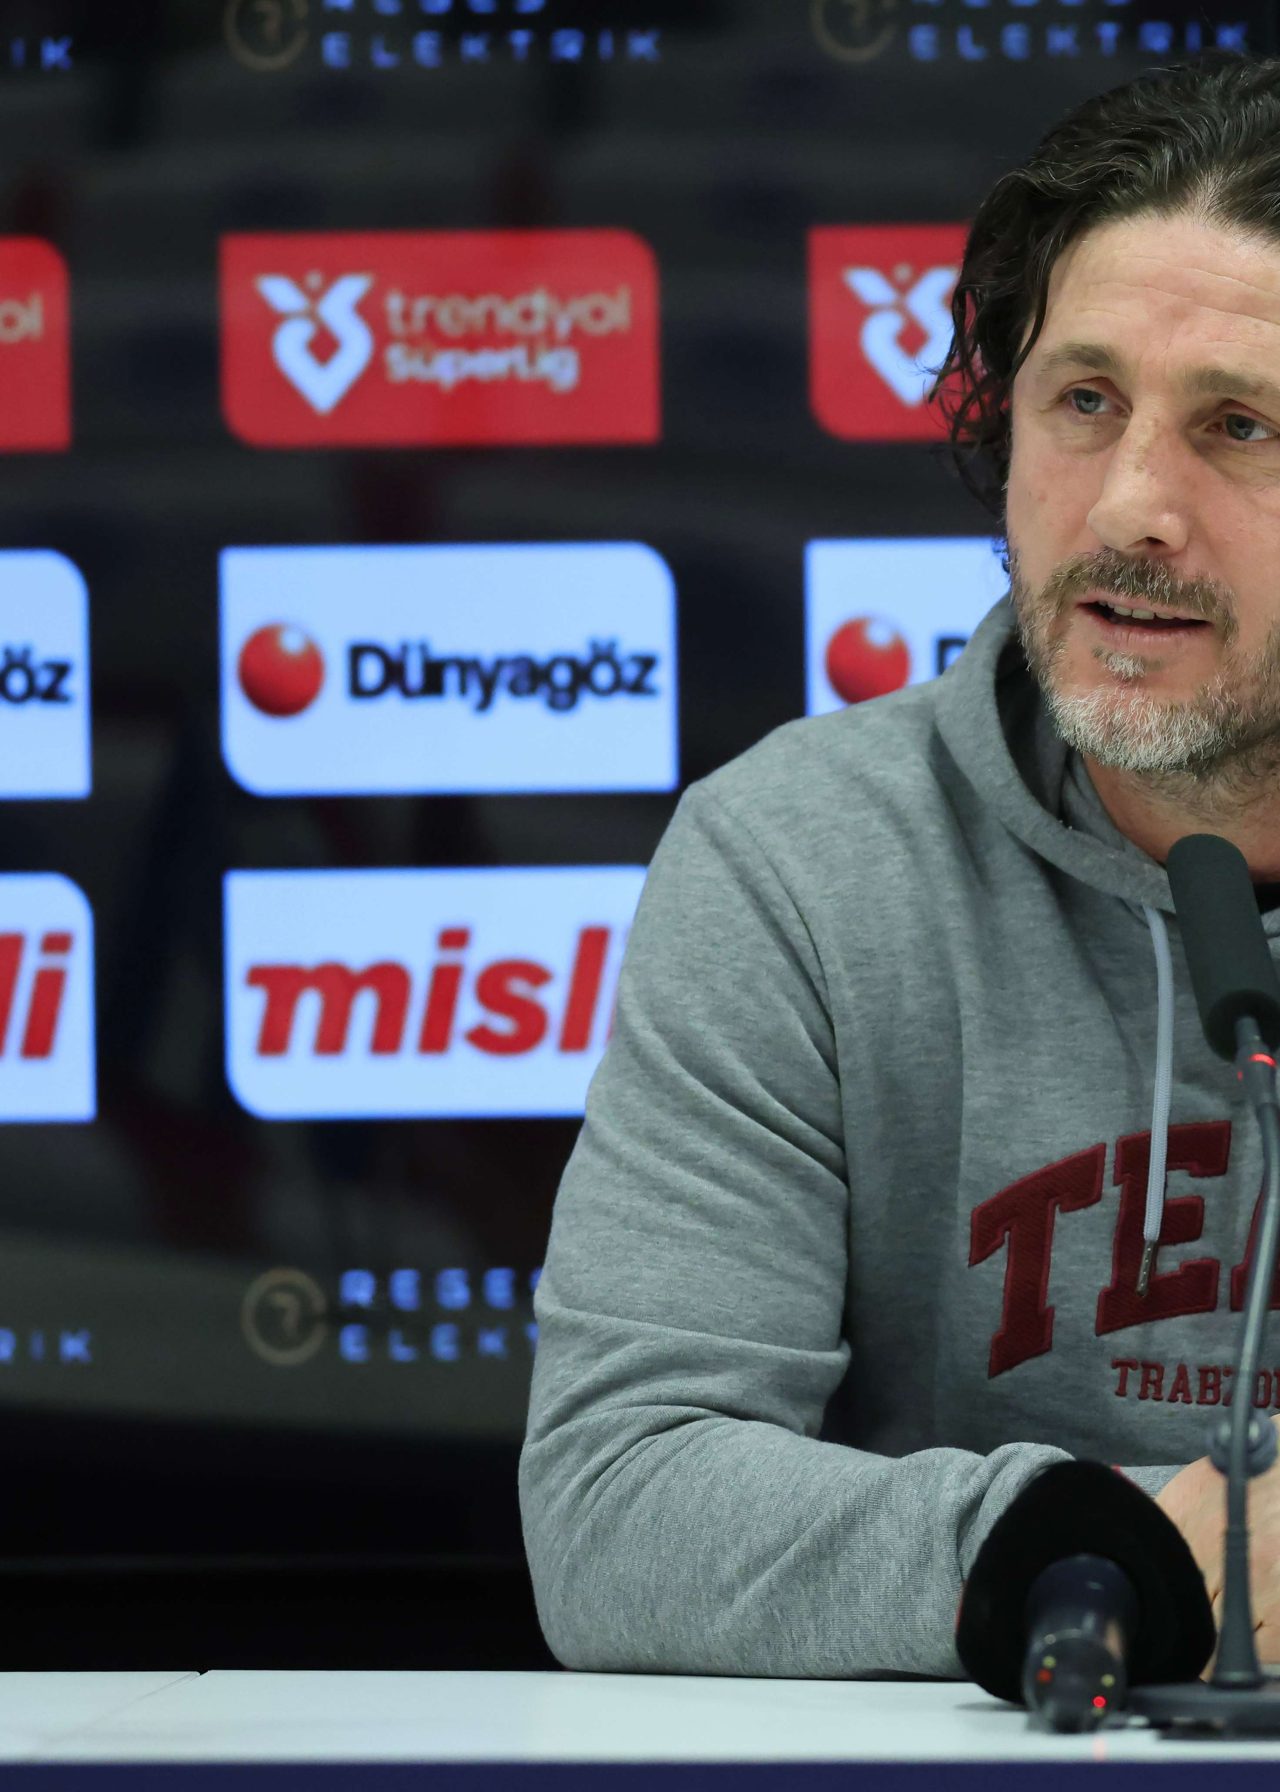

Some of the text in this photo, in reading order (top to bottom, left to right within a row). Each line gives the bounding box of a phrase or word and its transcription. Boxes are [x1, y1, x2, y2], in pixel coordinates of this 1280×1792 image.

[386, 283, 633, 342] trendyol
[349, 641, 658, 712] Dünyagöz
[245, 924, 613, 1057] misl
